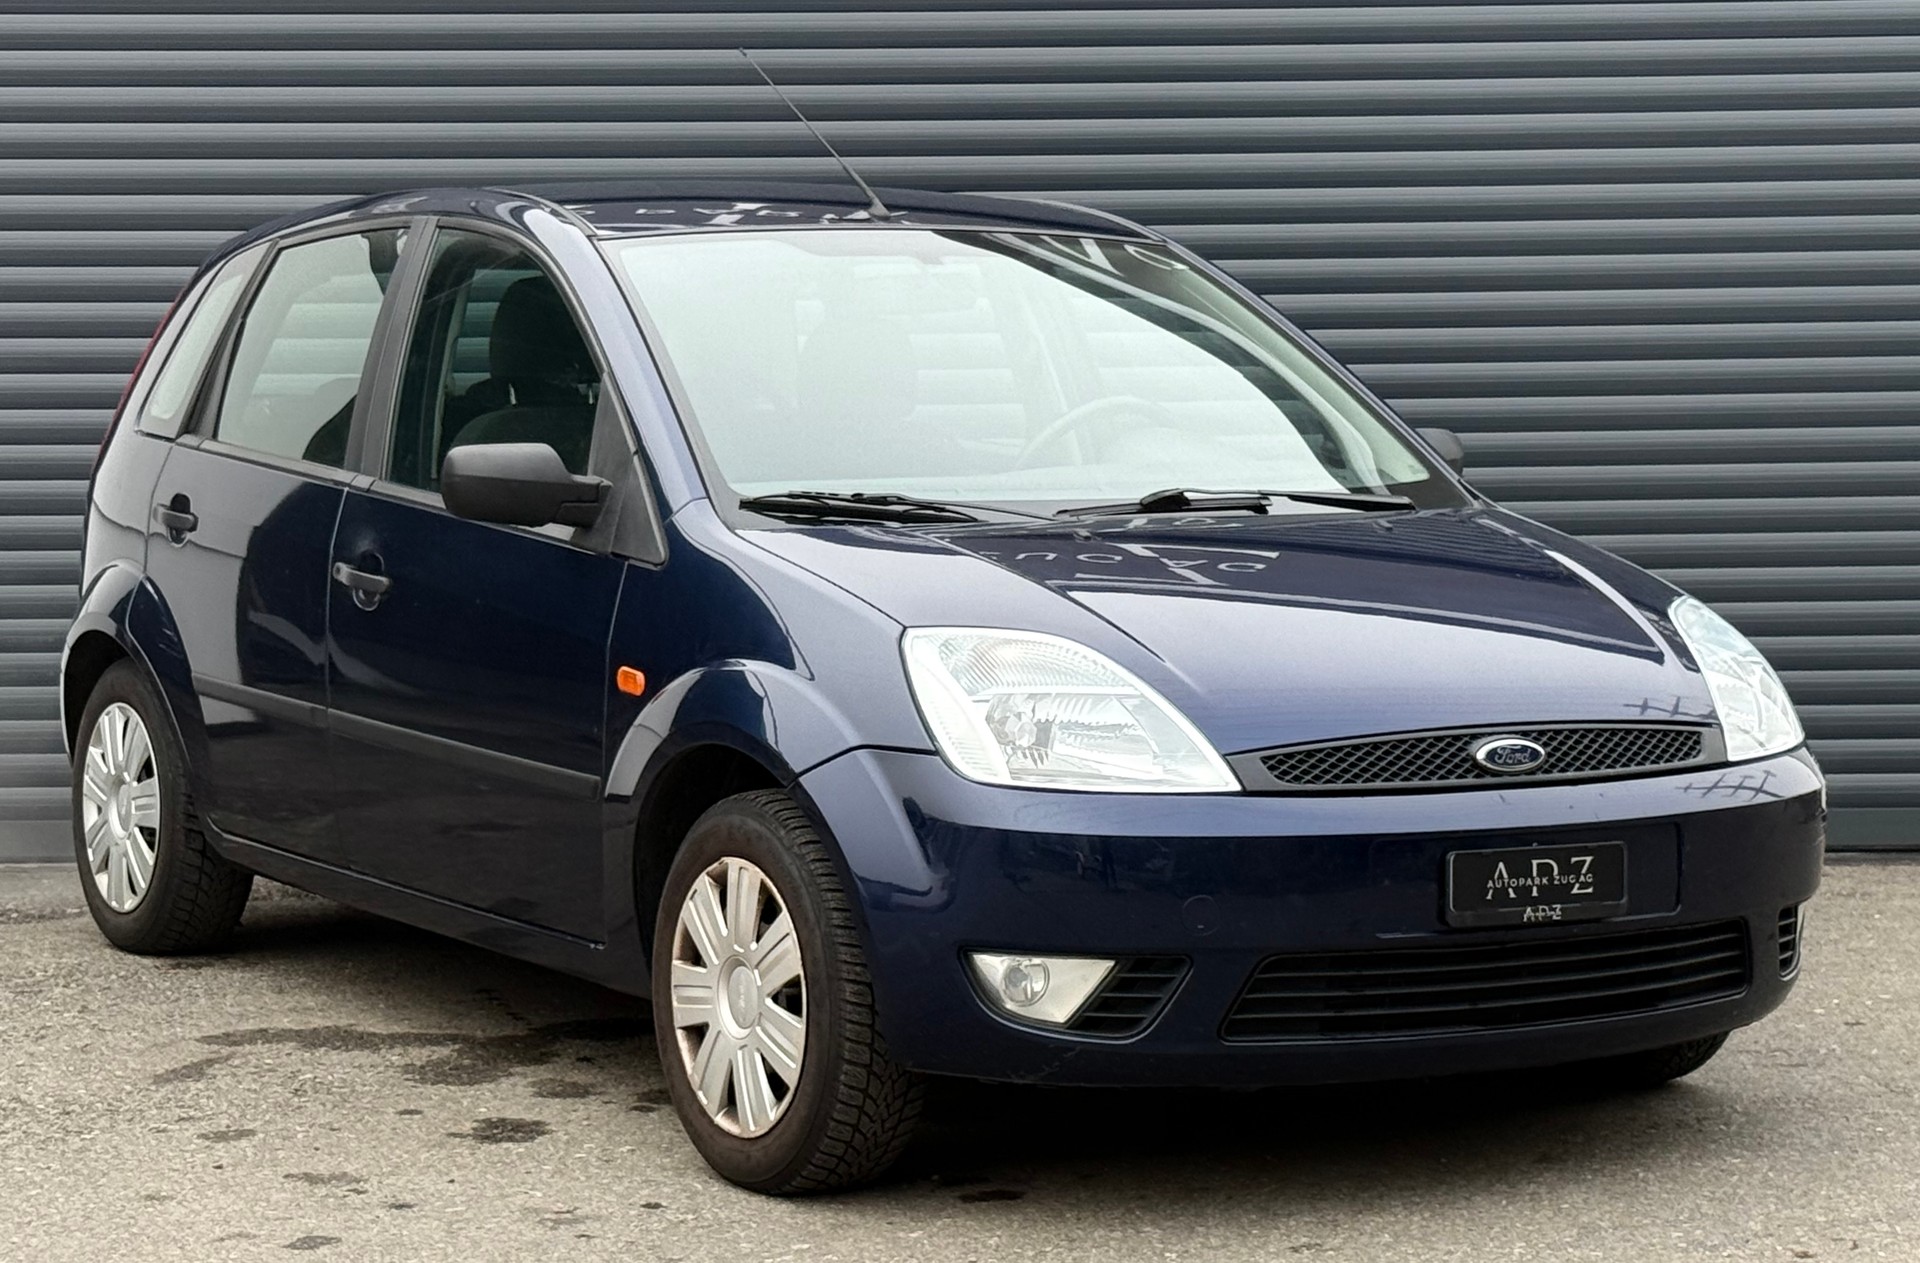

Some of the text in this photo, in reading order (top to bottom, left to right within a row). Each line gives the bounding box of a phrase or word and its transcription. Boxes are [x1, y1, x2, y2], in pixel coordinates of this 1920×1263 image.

[1494, 744, 1532, 763] Ford
[1487, 872, 1593, 888] AUTOPARK ZUG AG
